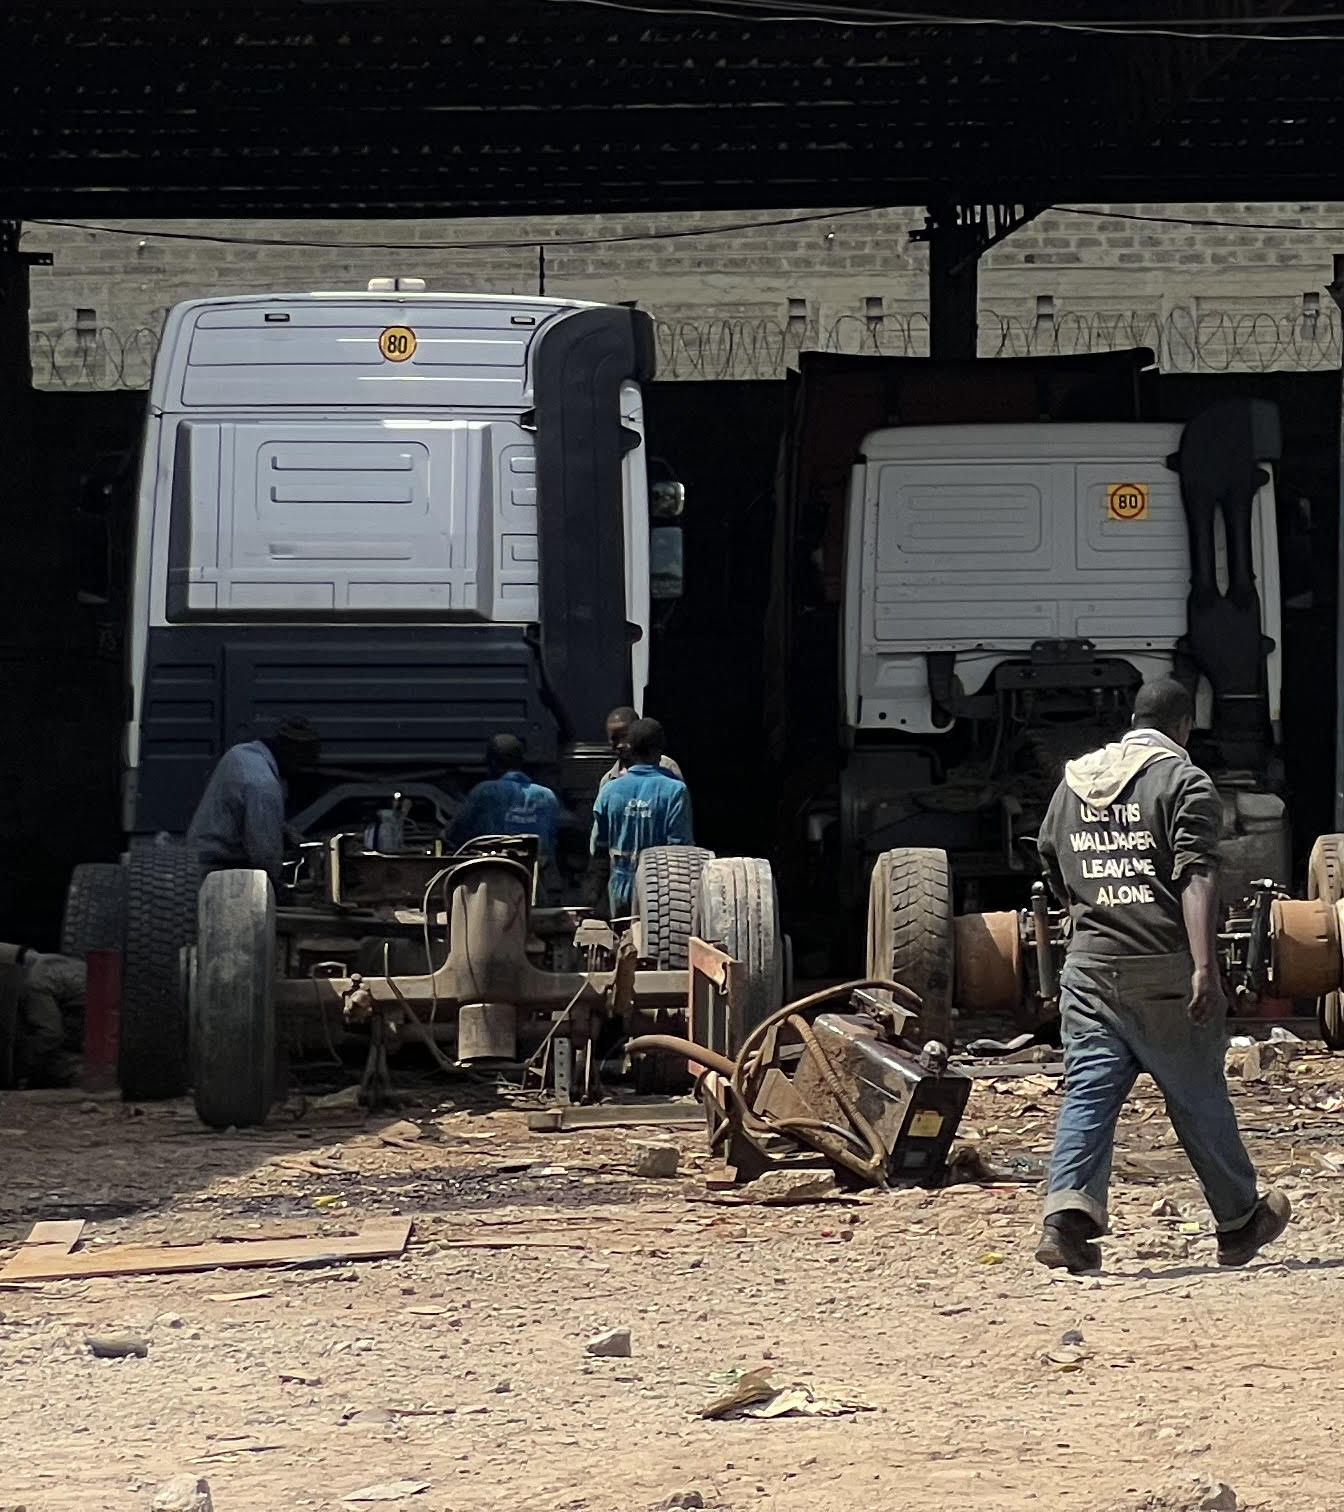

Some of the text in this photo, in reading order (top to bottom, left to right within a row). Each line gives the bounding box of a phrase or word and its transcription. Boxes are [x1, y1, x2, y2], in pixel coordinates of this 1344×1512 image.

[387, 334, 408, 354] 80
[1119, 494, 1138, 509] 80
[1069, 830, 1157, 853] WALLPAPER
[1082, 858, 1135, 879] LEAVE
[1096, 884, 1155, 907] ALONE
